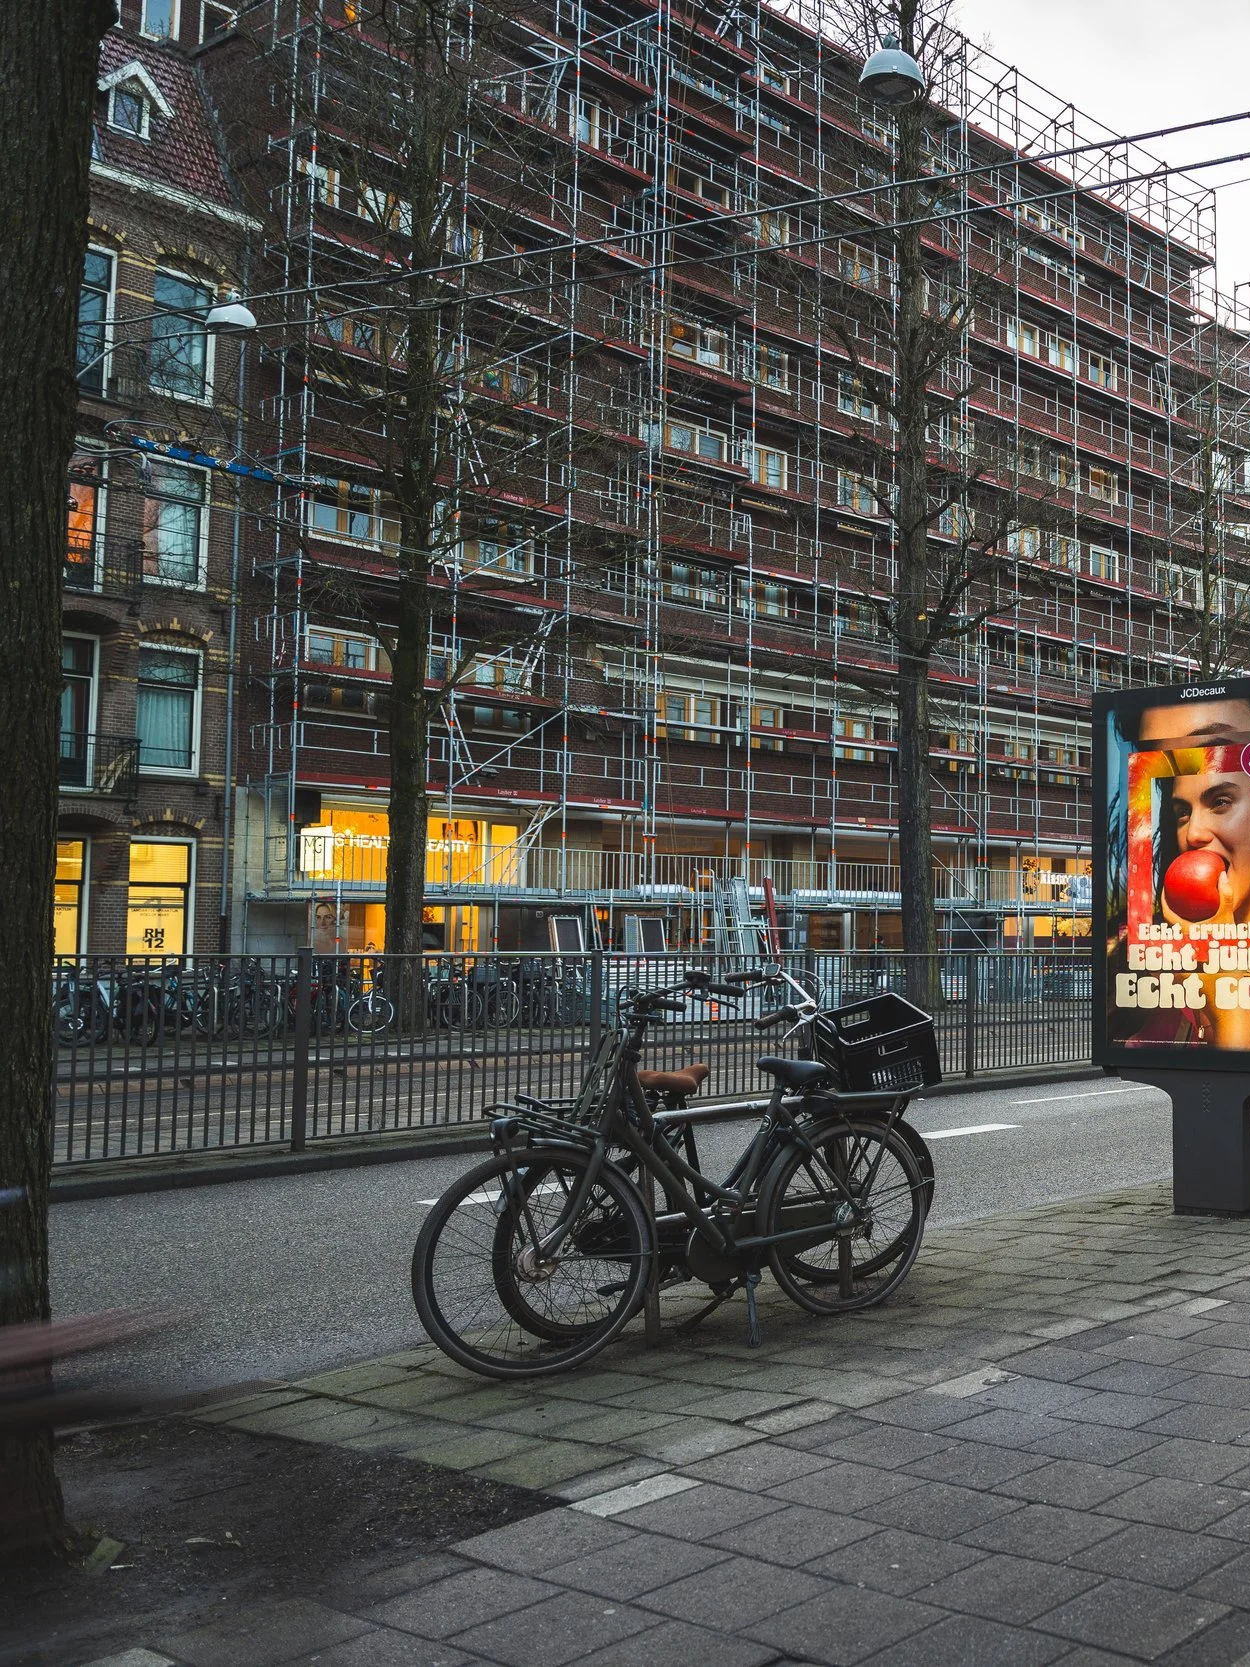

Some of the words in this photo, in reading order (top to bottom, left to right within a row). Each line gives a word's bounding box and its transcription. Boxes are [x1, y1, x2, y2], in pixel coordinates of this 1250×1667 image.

[1181, 686, 1226, 698] JCDecaux
[351, 835, 391, 849] HEALT
[144, 928, 164, 938] RH
[1138, 923, 1183, 940] Echt
[144, 938, 164, 948] 12
[1128, 943, 1198, 970] Echt
[1116, 972, 1206, 1010] Echt
